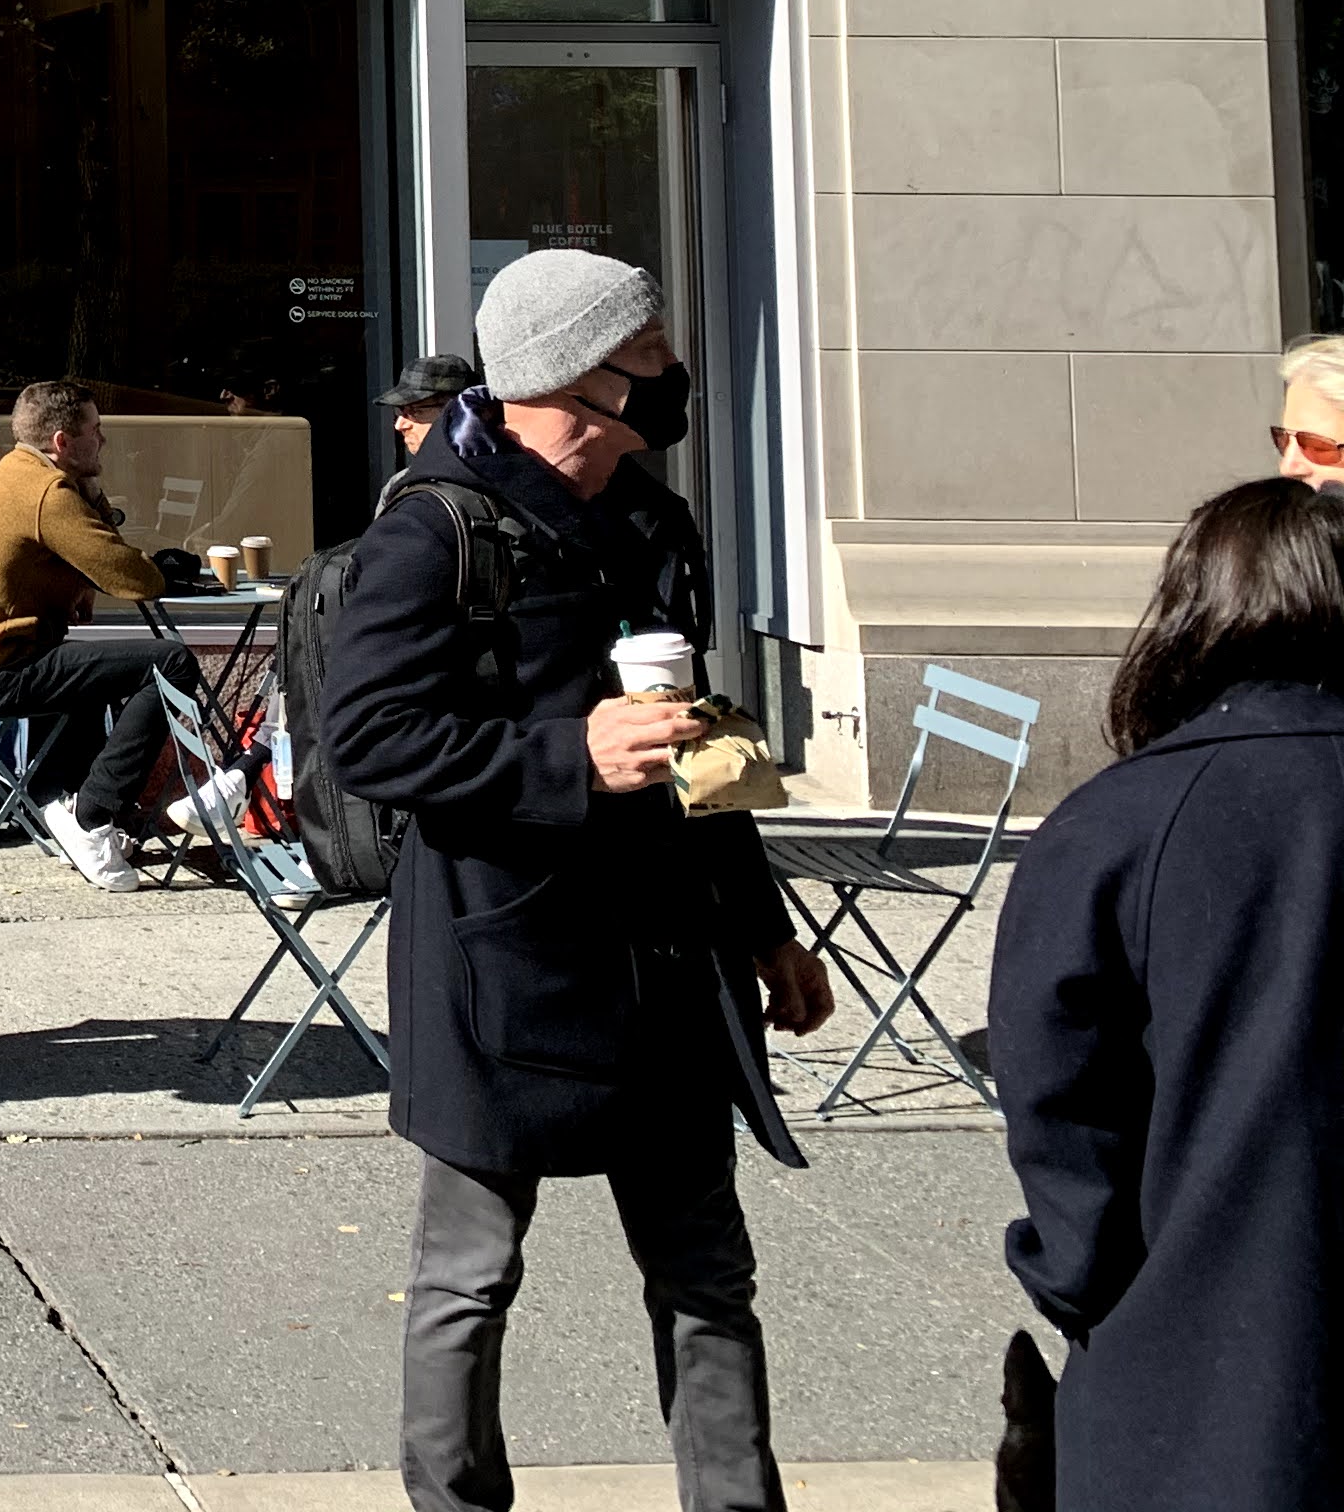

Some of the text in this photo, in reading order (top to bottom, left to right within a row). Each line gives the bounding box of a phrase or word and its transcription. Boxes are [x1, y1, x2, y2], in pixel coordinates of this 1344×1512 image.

[531, 224, 613, 234] BLUE BOTTLE
[548, 236, 598, 247] COFFEE
